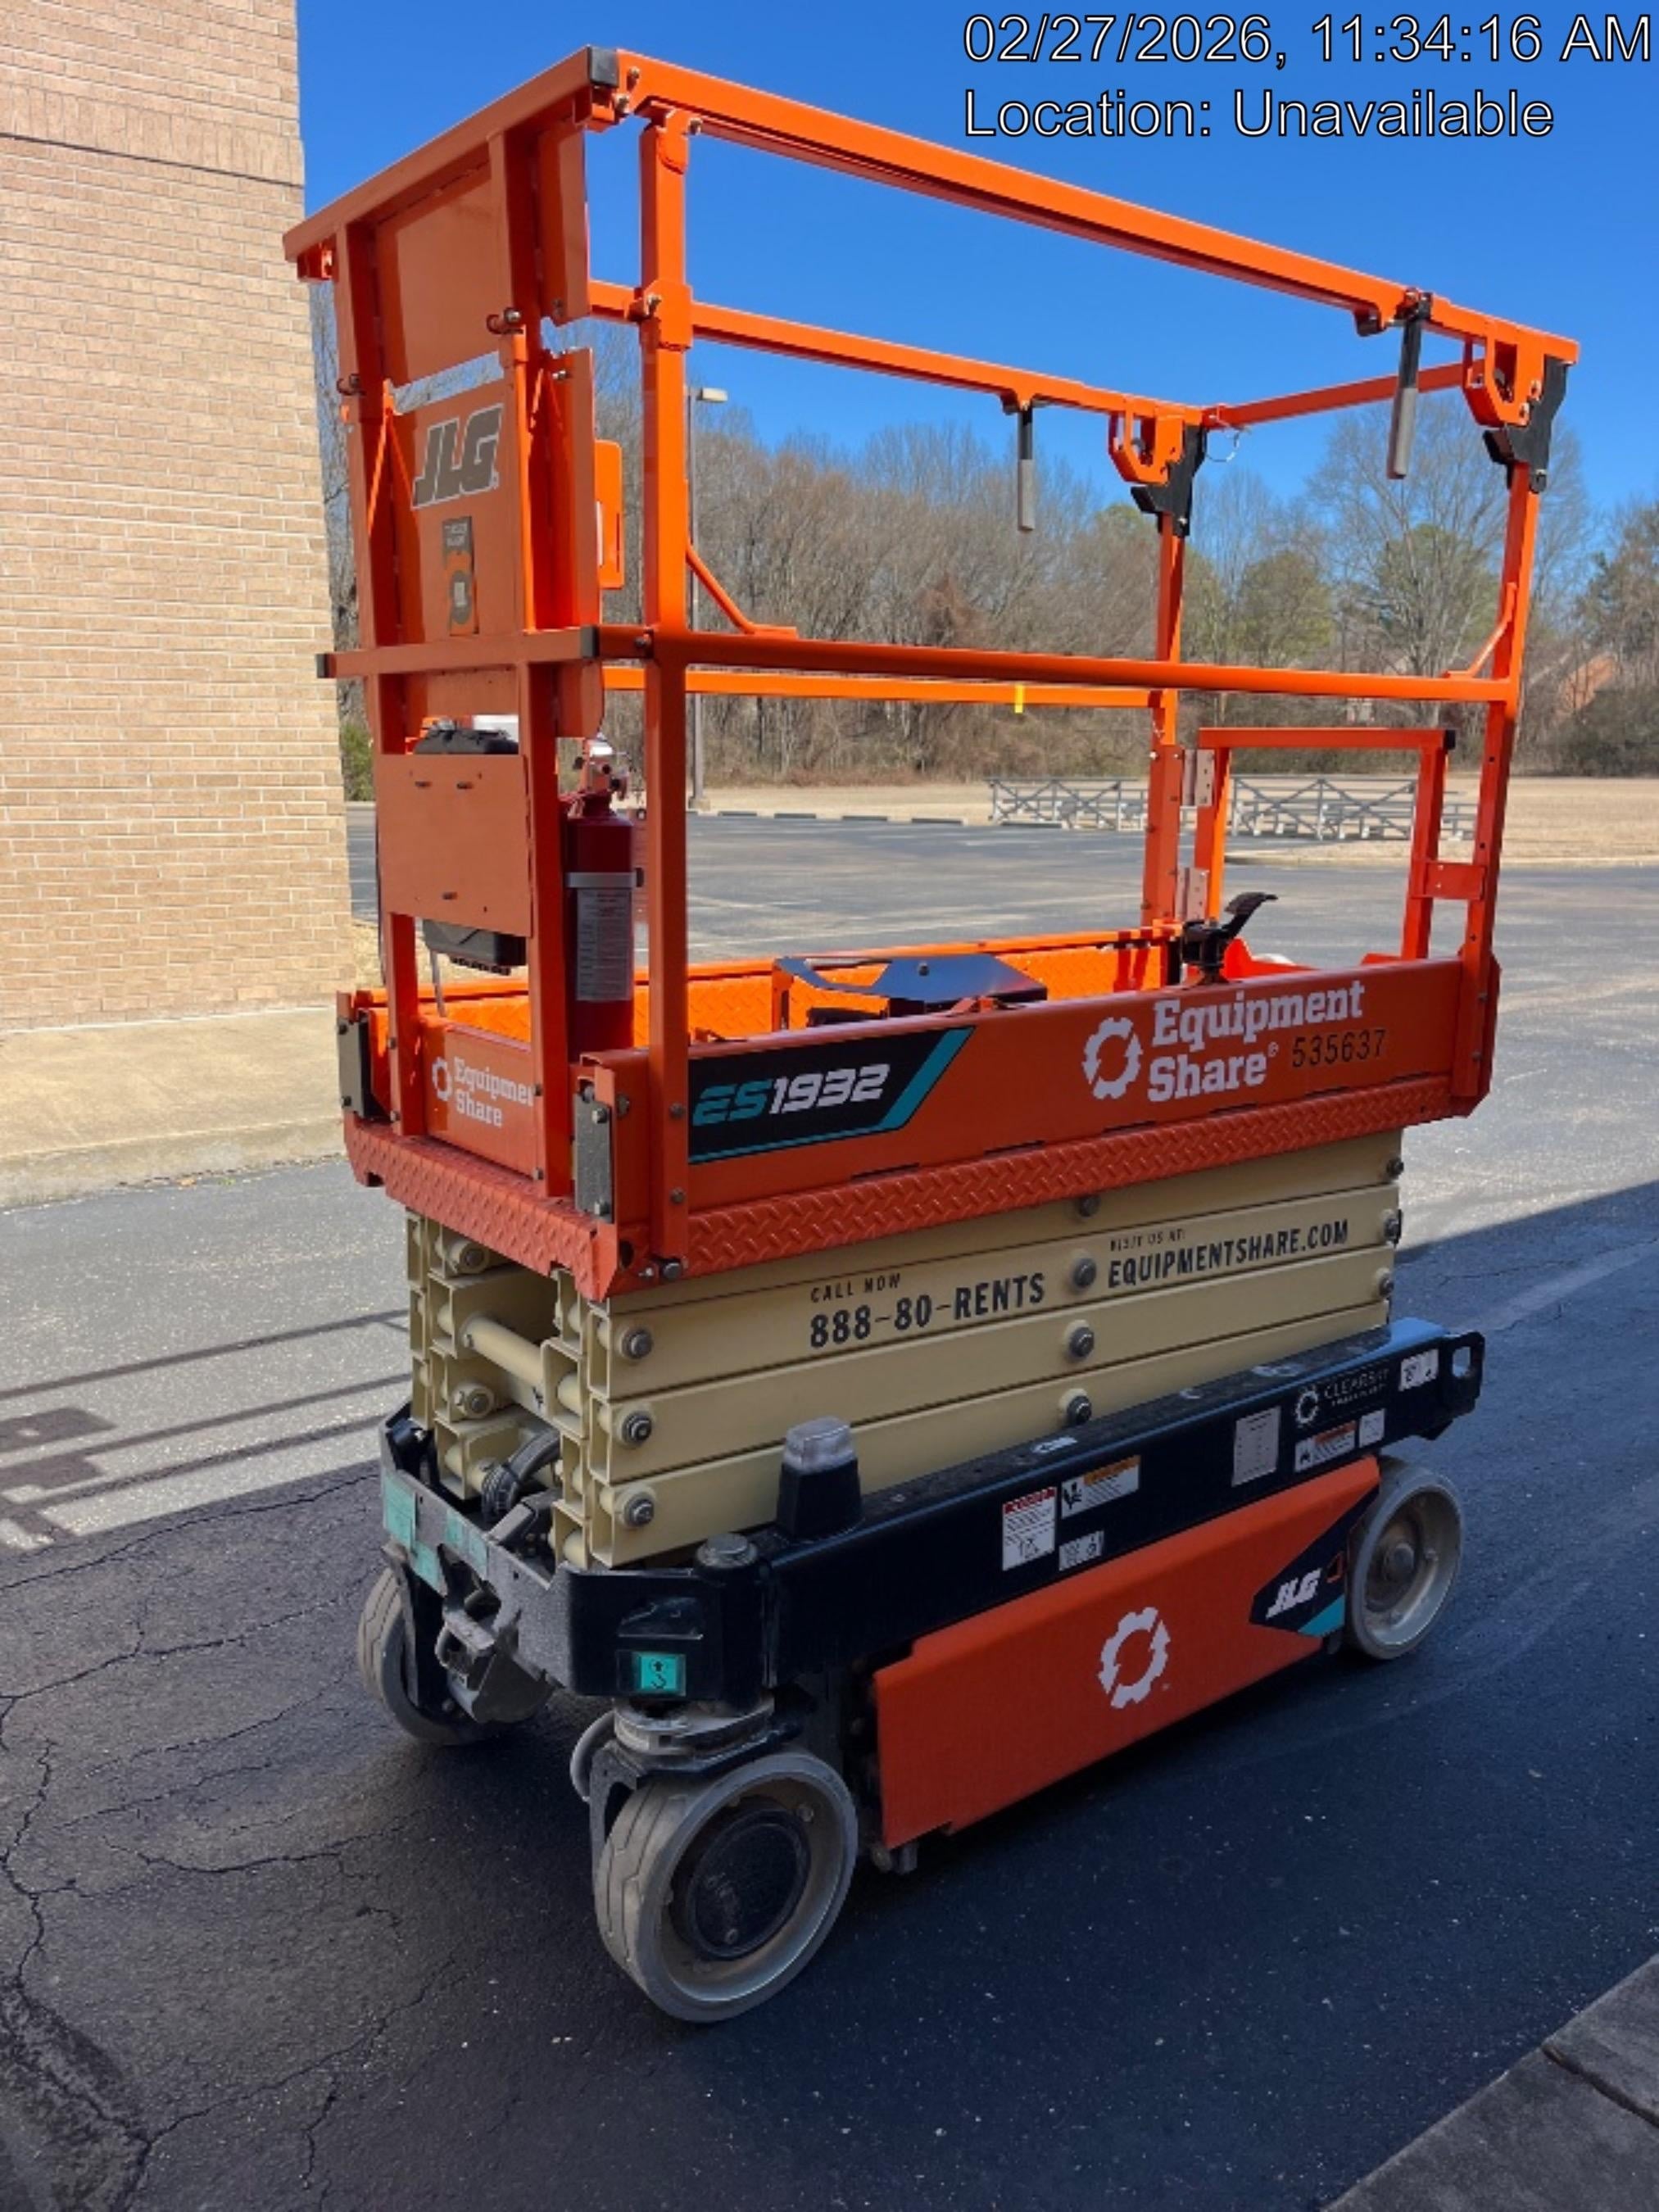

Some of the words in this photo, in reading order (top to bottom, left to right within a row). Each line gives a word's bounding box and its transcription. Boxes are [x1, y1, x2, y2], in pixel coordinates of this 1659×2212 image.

[410, 402, 503, 510] JLG
[1152, 981, 1365, 1052] Equipment
[1292, 1030, 1385, 1067] 535637
[456, 1088, 502, 1127] Share
[692, 1063, 891, 1126] ES1932
[1108, 1218, 1349, 1289] EQUIPMENTSHARE.COM
[810, 1281, 854, 1303] CALL
[864, 1273, 900, 1293] NOW
[810, 1272, 1045, 1348] 888-80-RENTS
[1265, 1568, 1321, 1620] JLG
